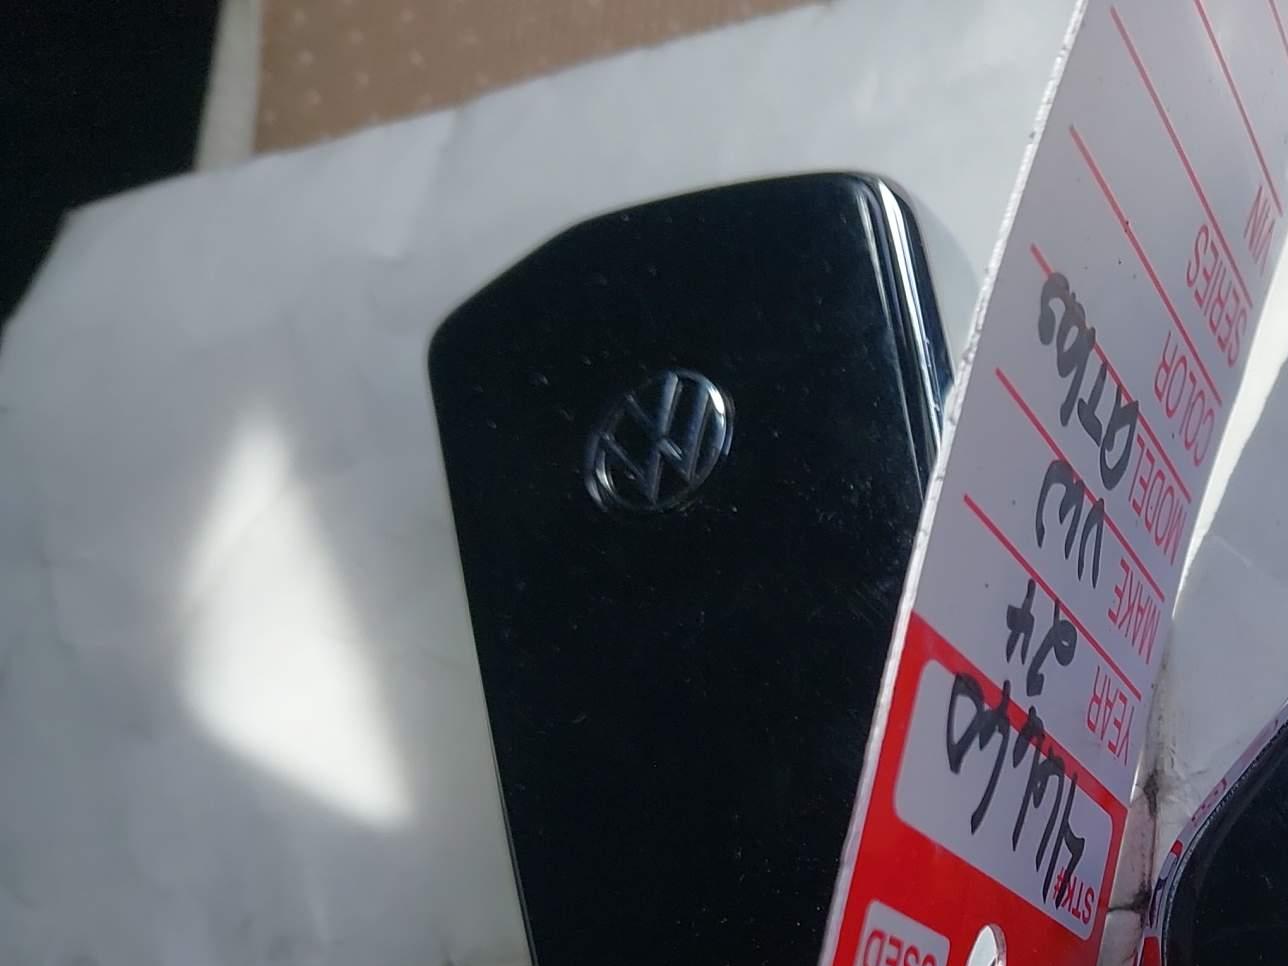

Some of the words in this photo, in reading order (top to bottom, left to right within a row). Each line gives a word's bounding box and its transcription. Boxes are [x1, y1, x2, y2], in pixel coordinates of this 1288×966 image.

[1186, 223, 1248, 368] SERIES
[1153, 330, 1215, 467] COLOR
[1128, 433, 1188, 566] MODEL
[1006, 578, 1078, 697] 24
[1108, 557, 1161, 665] MAKE
[1086, 665, 1130, 766] YEAR
